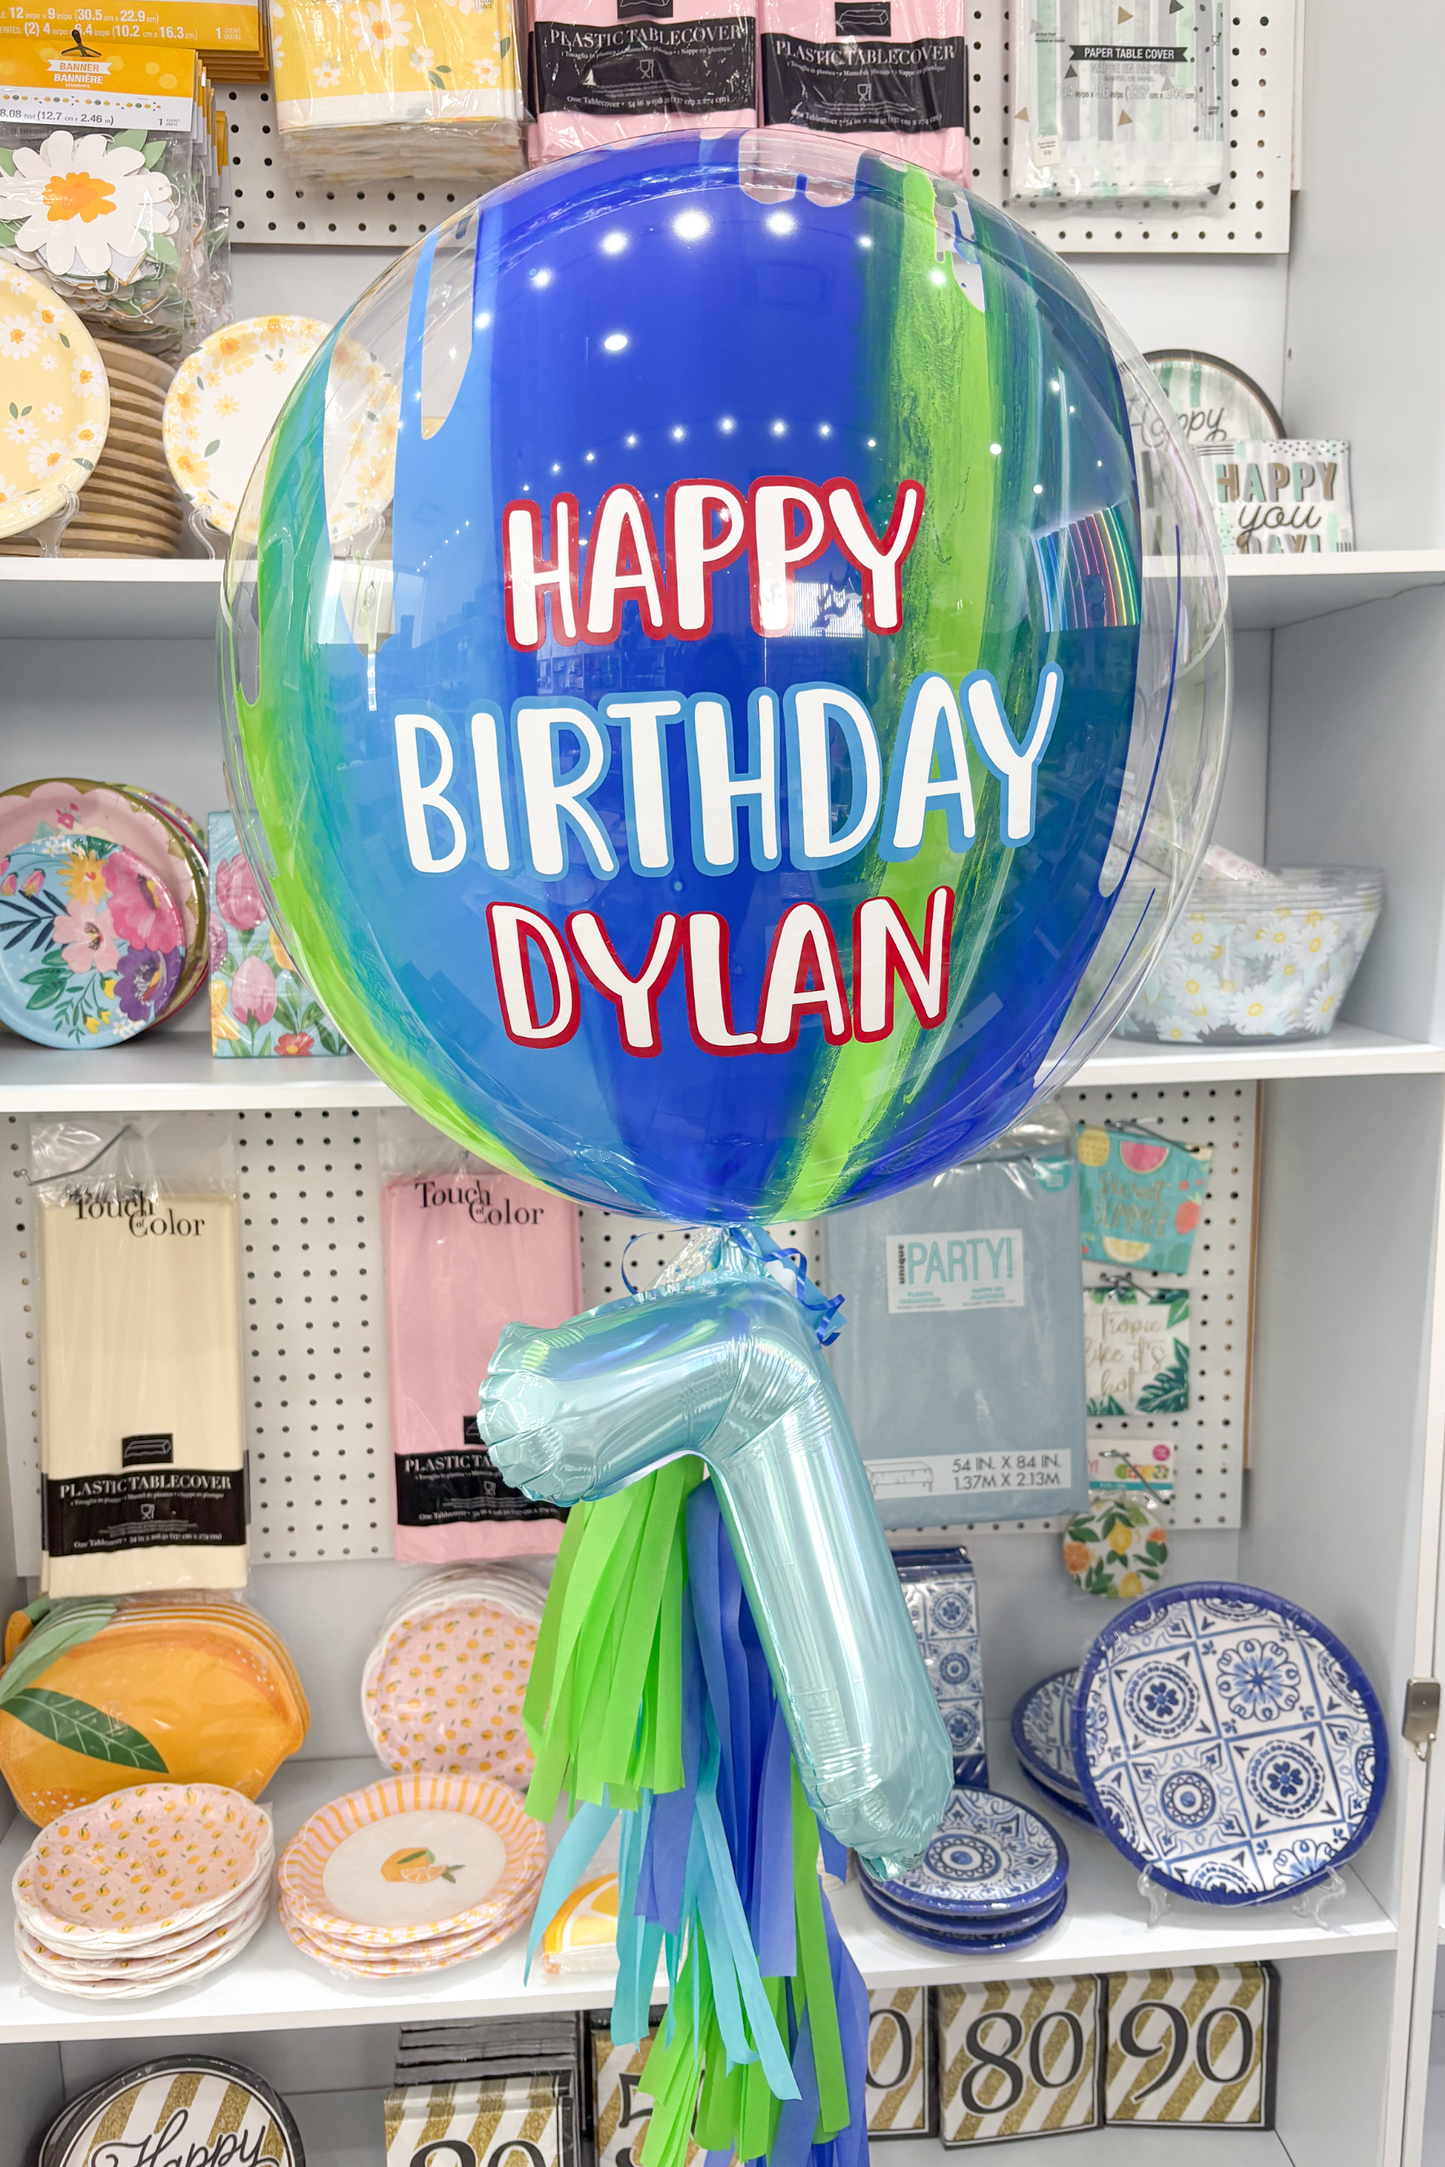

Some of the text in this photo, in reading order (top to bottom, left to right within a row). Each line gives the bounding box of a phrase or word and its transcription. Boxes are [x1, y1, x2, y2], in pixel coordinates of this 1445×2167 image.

[9, 7, 24, 19] 12
[47, 8, 56, 20] 9
[75, 8, 103, 22] (30.5
[120, 10, 146, 22] 22.9
[24, 22, 39, 37] (2)
[43, 23, 51, 34] 4
[112, 25, 140, 38] (10.2
[159, 26, 185, 39] 16.3
[550, 24, 743, 49] PLASTIC TABLECOVER
[776, 40, 955, 66] PLASTIC TABLECOVER
[1084, 47, 1175, 60] PAPER TABLE COVER
[54, 72, 104, 85] BANNIÈRE
[60, 62, 100, 72] BANNER
[583, 97, 620, 108] Tablecover
[37, 110, 63, 121] (12.7
[80, 114, 103, 123] 2.46
[1214, 462, 1338, 503] HAPPY
[1238, 505, 1322, 550] you
[502, 475, 925, 652] HAPPY
[390, 662, 1064, 878] BIRTHDAY
[485, 886, 956, 1057] DYLAN
[68, 1187, 155, 1220] Touch
[415, 1180, 492, 1208] Touch
[128, 1208, 205, 1238] Color
[468, 1198, 544, 1226] Color
[1092, 1198, 1169, 1239] SUMMER
[906, 1237, 1014, 1285] PARTY!
[404, 1454, 492, 1473] PLASTIC TA
[951, 1458, 971, 1473] 54
[60, 1474, 232, 1499] PLASTIC TABLECOVER
[1000, 1472, 1012, 1487] X
[1016, 1472, 1061, 1487] 2.13M
[960, 2011, 1083, 2113] 80
[1119, 2002, 1253, 2101] 90
